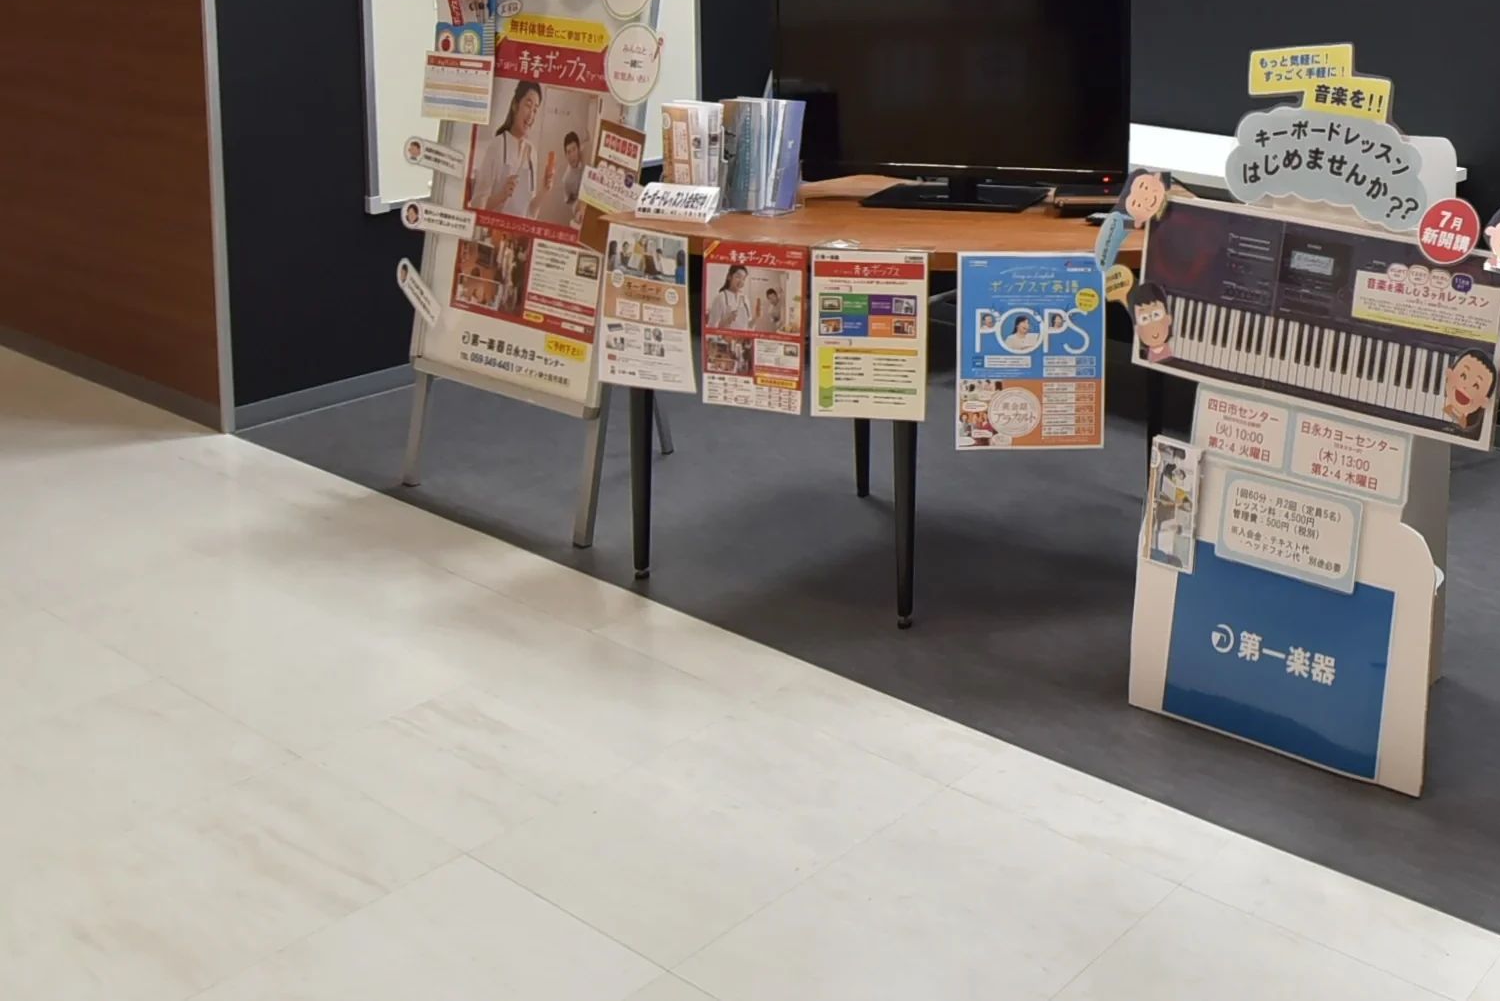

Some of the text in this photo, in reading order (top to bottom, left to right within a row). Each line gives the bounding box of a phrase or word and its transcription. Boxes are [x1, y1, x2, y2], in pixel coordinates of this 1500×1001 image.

[519, 50, 586, 83] 青春ポップス
[1259, 52, 1330, 70] もっと気軽に!
[1264, 65, 1346, 81] すっごく手軽に!
[1314, 84, 1384, 113] 音楽を!!
[1254, 120, 1409, 176] キーボードレッスン
[1242, 147, 1419, 220] はじめませんか??
[1440, 210, 1463, 230] 7月
[1422, 226, 1471, 253] 新開講
[975, 307, 1090, 354] POPS
[1208, 397, 1279, 423] 四日市センター
[1215, 423, 1264, 445] (火) 10:00
[1300, 420, 1399, 453] 日永カヨーセンター
[1239, 442, 1271, 463] 火曜日
[1318, 449, 1370, 472] (木) 13:00
[1345, 470, 1378, 491] 木曜日
[1237, 631, 1336, 686] 第一楽器
